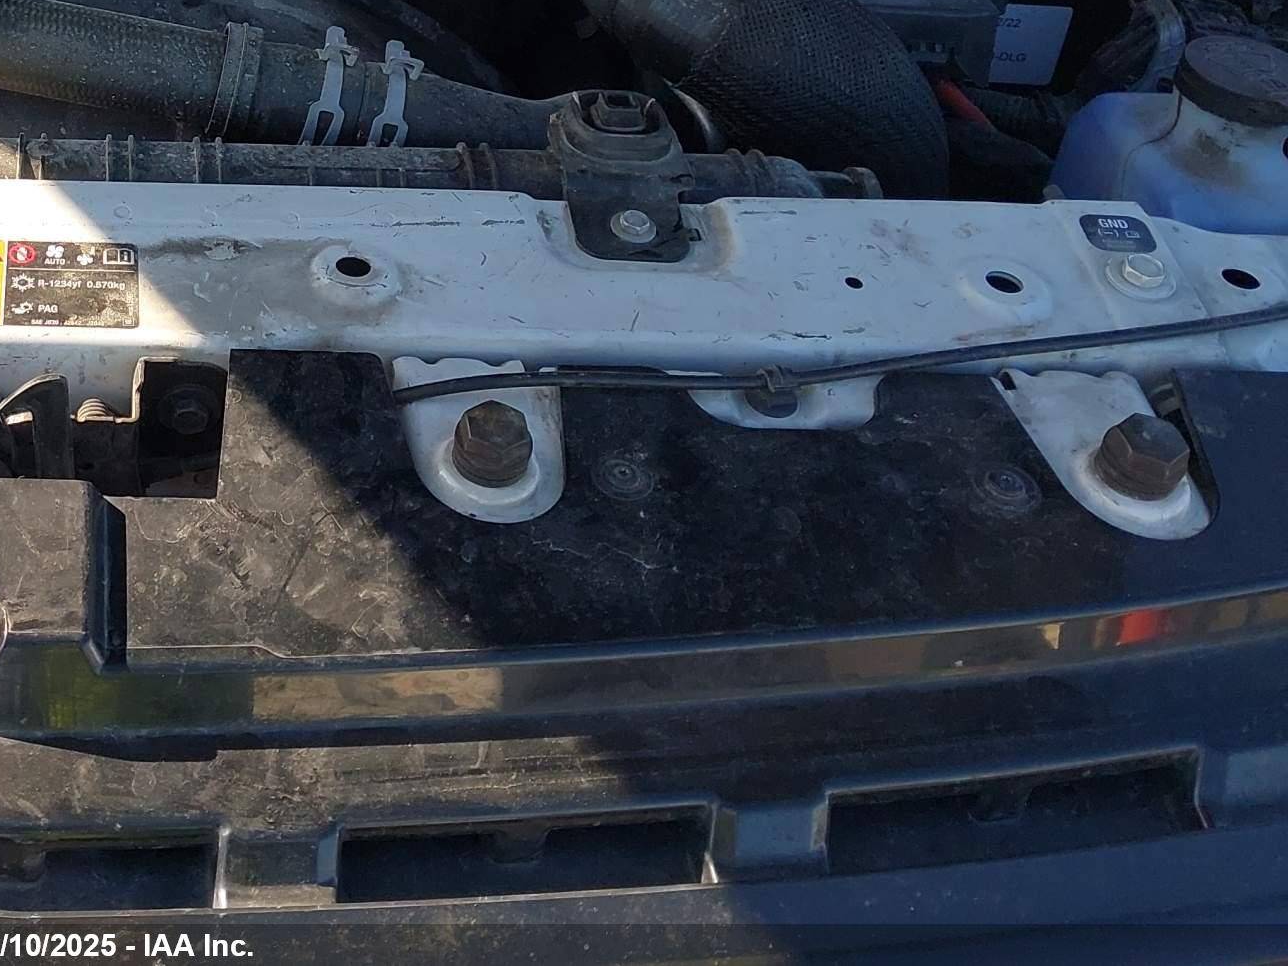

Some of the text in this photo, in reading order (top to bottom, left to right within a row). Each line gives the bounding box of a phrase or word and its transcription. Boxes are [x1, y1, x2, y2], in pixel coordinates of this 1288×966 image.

[1098, 218, 1129, 229] GND
[44, 258, 66, 266] AUTO
[38, 279, 82, 290] R-1234yf
[38, 304, 58, 314] PAG
